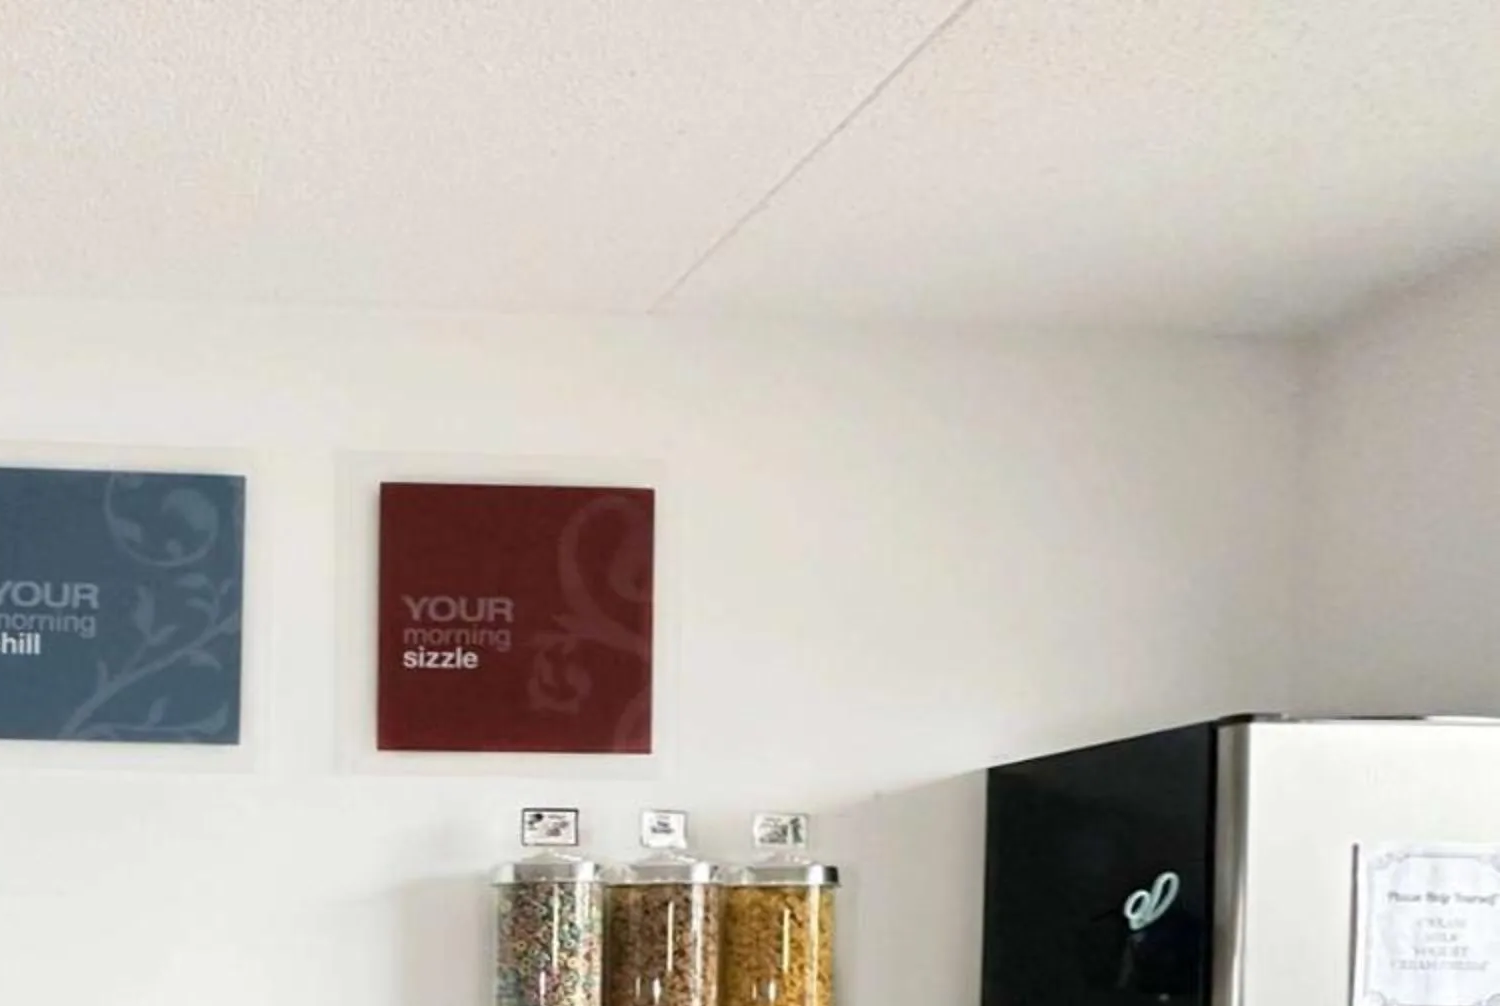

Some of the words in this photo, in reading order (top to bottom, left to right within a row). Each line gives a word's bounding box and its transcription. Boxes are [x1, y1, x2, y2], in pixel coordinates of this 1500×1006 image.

[403, 595, 514, 622] YOUR
[403, 624, 511, 652] morning
[403, 646, 478, 669] sizzle
